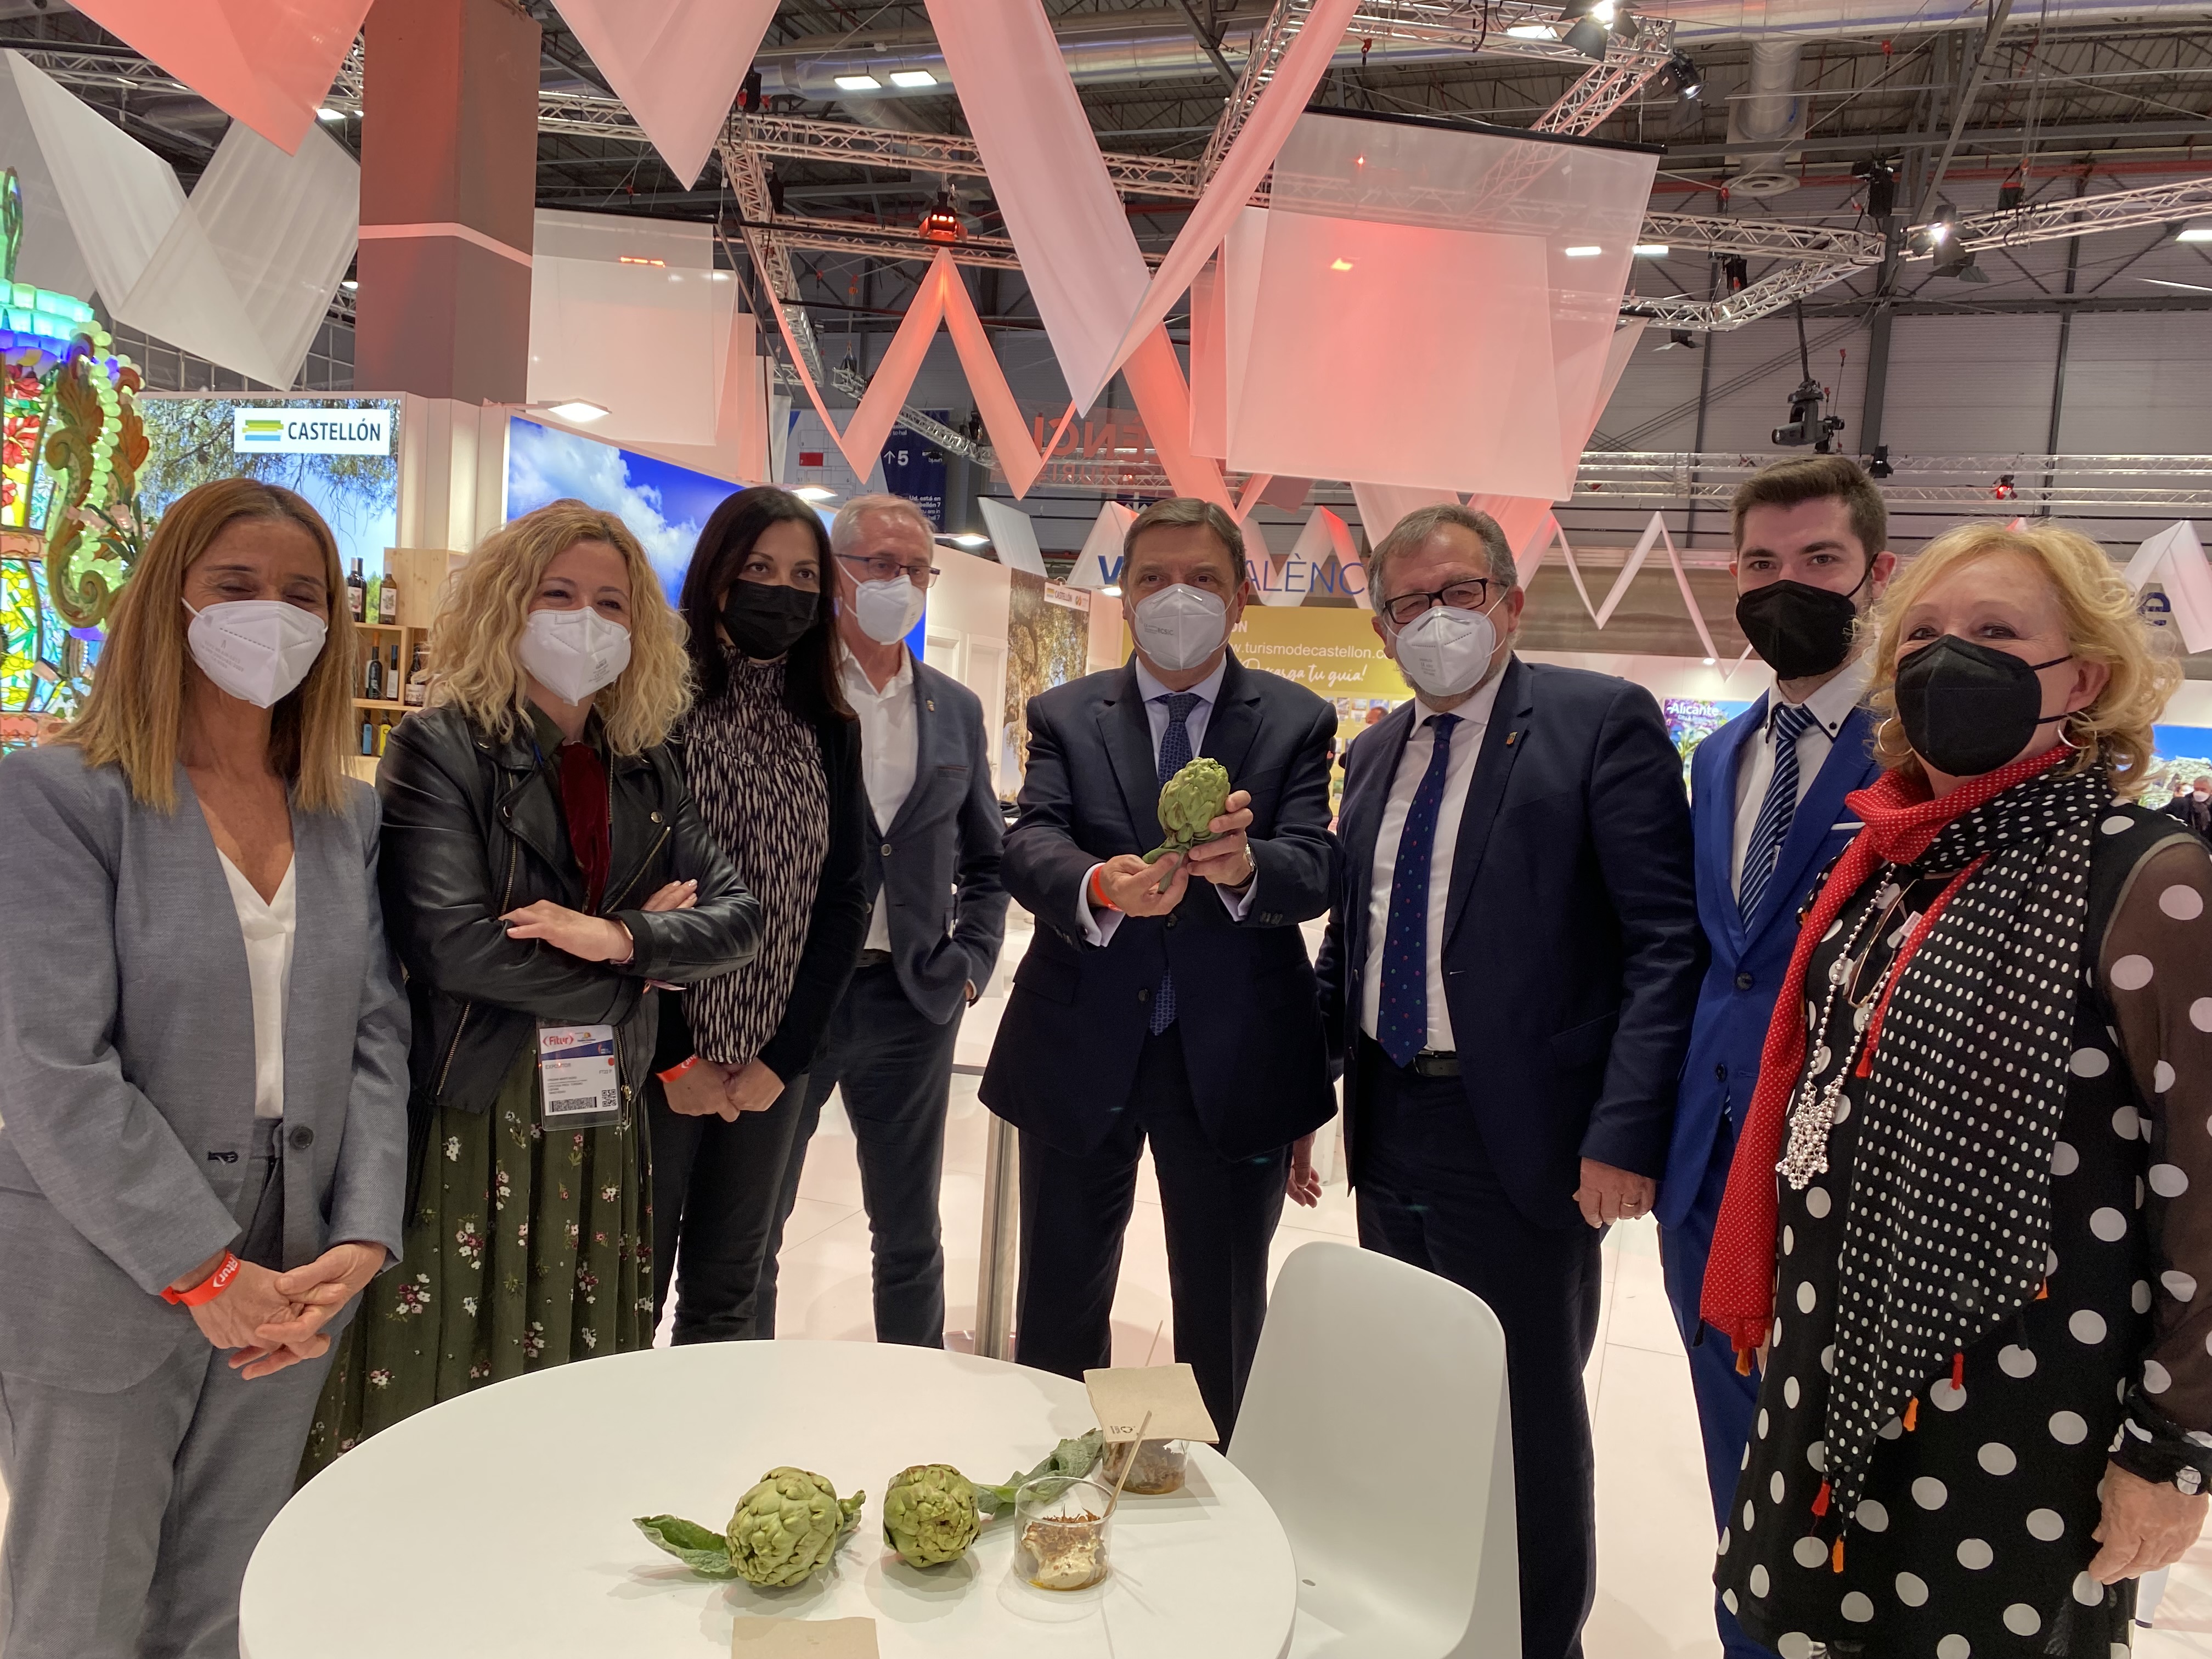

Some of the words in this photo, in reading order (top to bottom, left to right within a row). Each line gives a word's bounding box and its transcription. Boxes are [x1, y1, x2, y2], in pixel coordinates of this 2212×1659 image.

[288, 418, 381, 442] CASTELLÓN
[898, 450, 909, 466] 5
[1055, 590, 1073, 602] CASTELLÓN
[1308, 663, 1325, 683] tu
[1667, 703, 1719, 716] Alicante
[549, 1035, 569, 1045] Fitur
